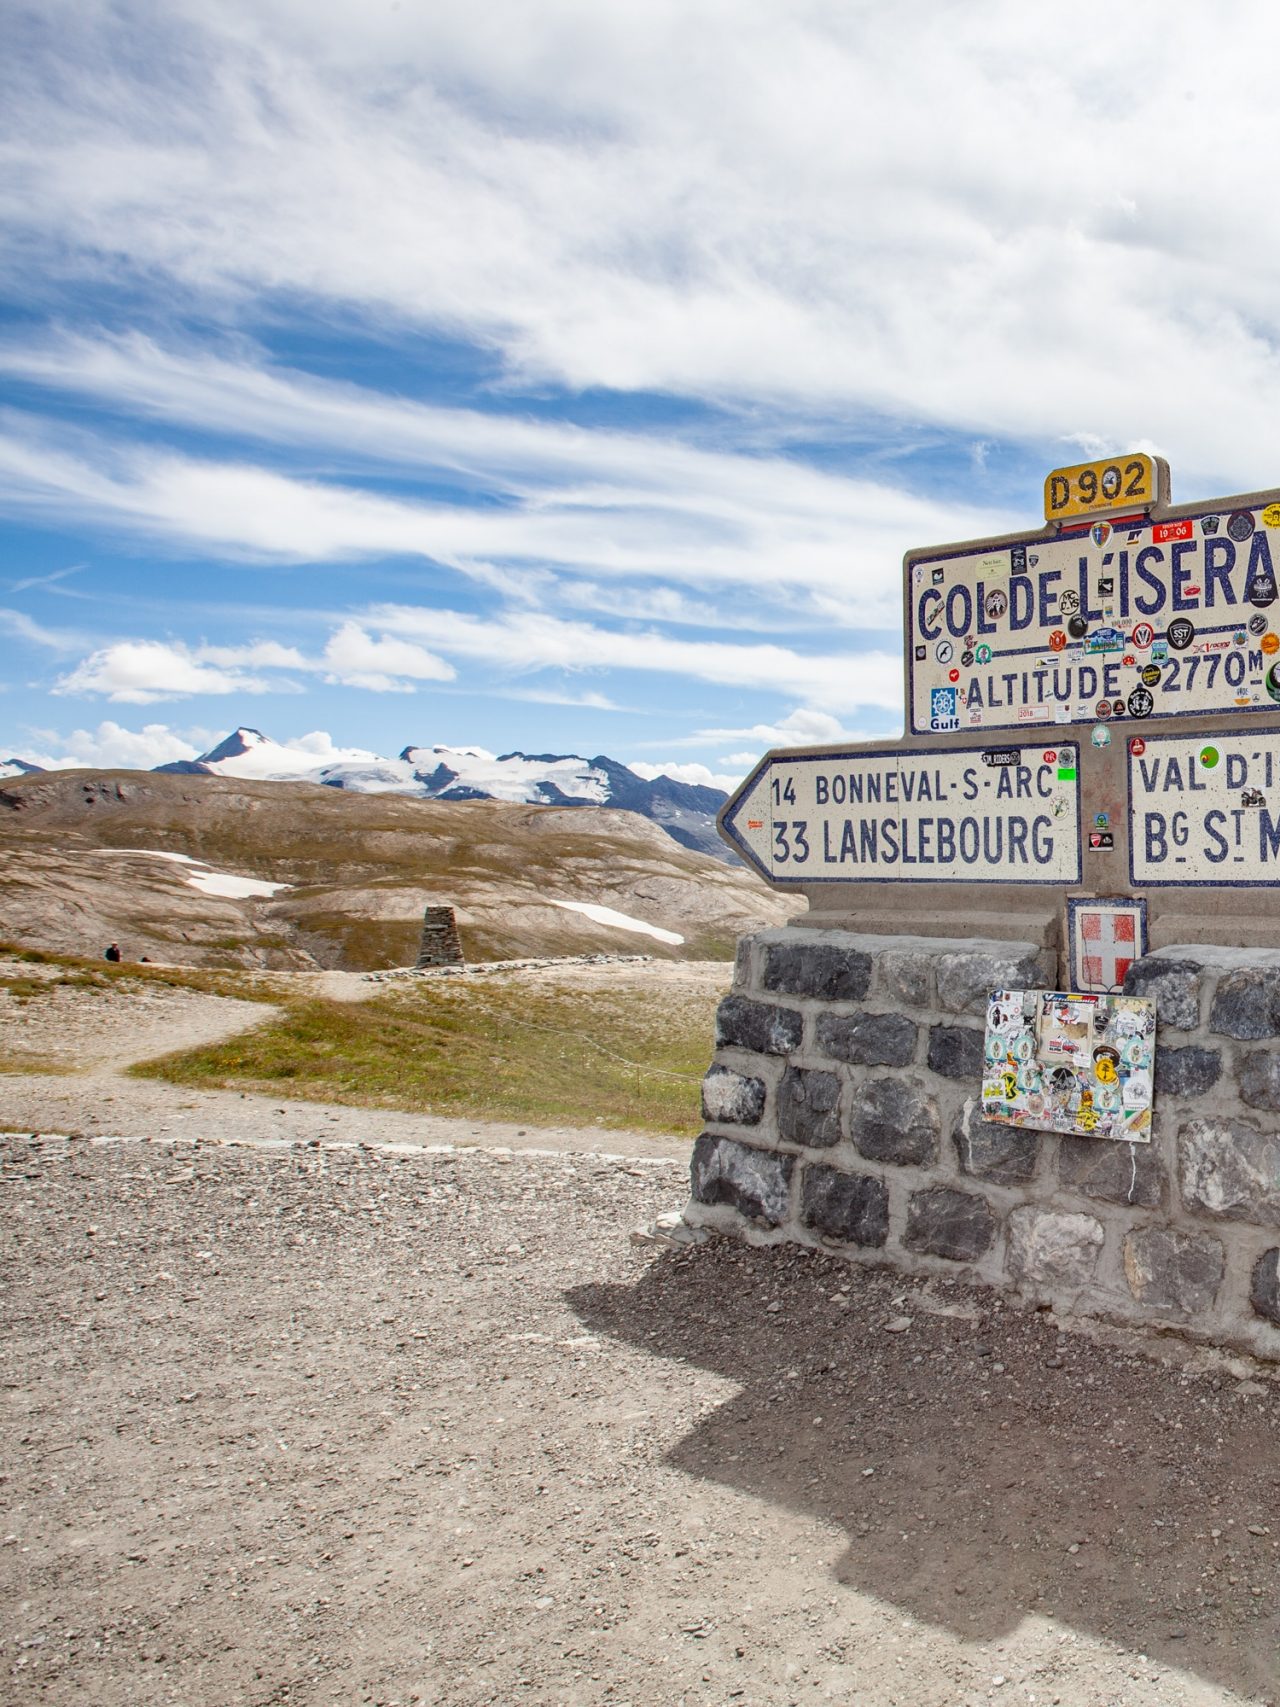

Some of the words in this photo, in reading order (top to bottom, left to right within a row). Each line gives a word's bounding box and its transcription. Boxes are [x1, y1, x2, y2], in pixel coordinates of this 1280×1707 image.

[1051, 476, 1070, 510] D
[1078, 461, 1145, 504] 902
[918, 581, 997, 641] COL
[1009, 570, 1064, 630] DE
[1174, 629, 1188, 639] SST
[965, 662, 1121, 709] ALTITUDE
[930, 718, 960, 731] Gulf
[772, 777, 797, 806] 14
[816, 765, 1055, 806] BONNEVAL-S-ARC
[1139, 753, 1208, 793] VAL
[772, 820, 810, 864] 33
[823, 814, 1055, 864] LANSLEBOURG
